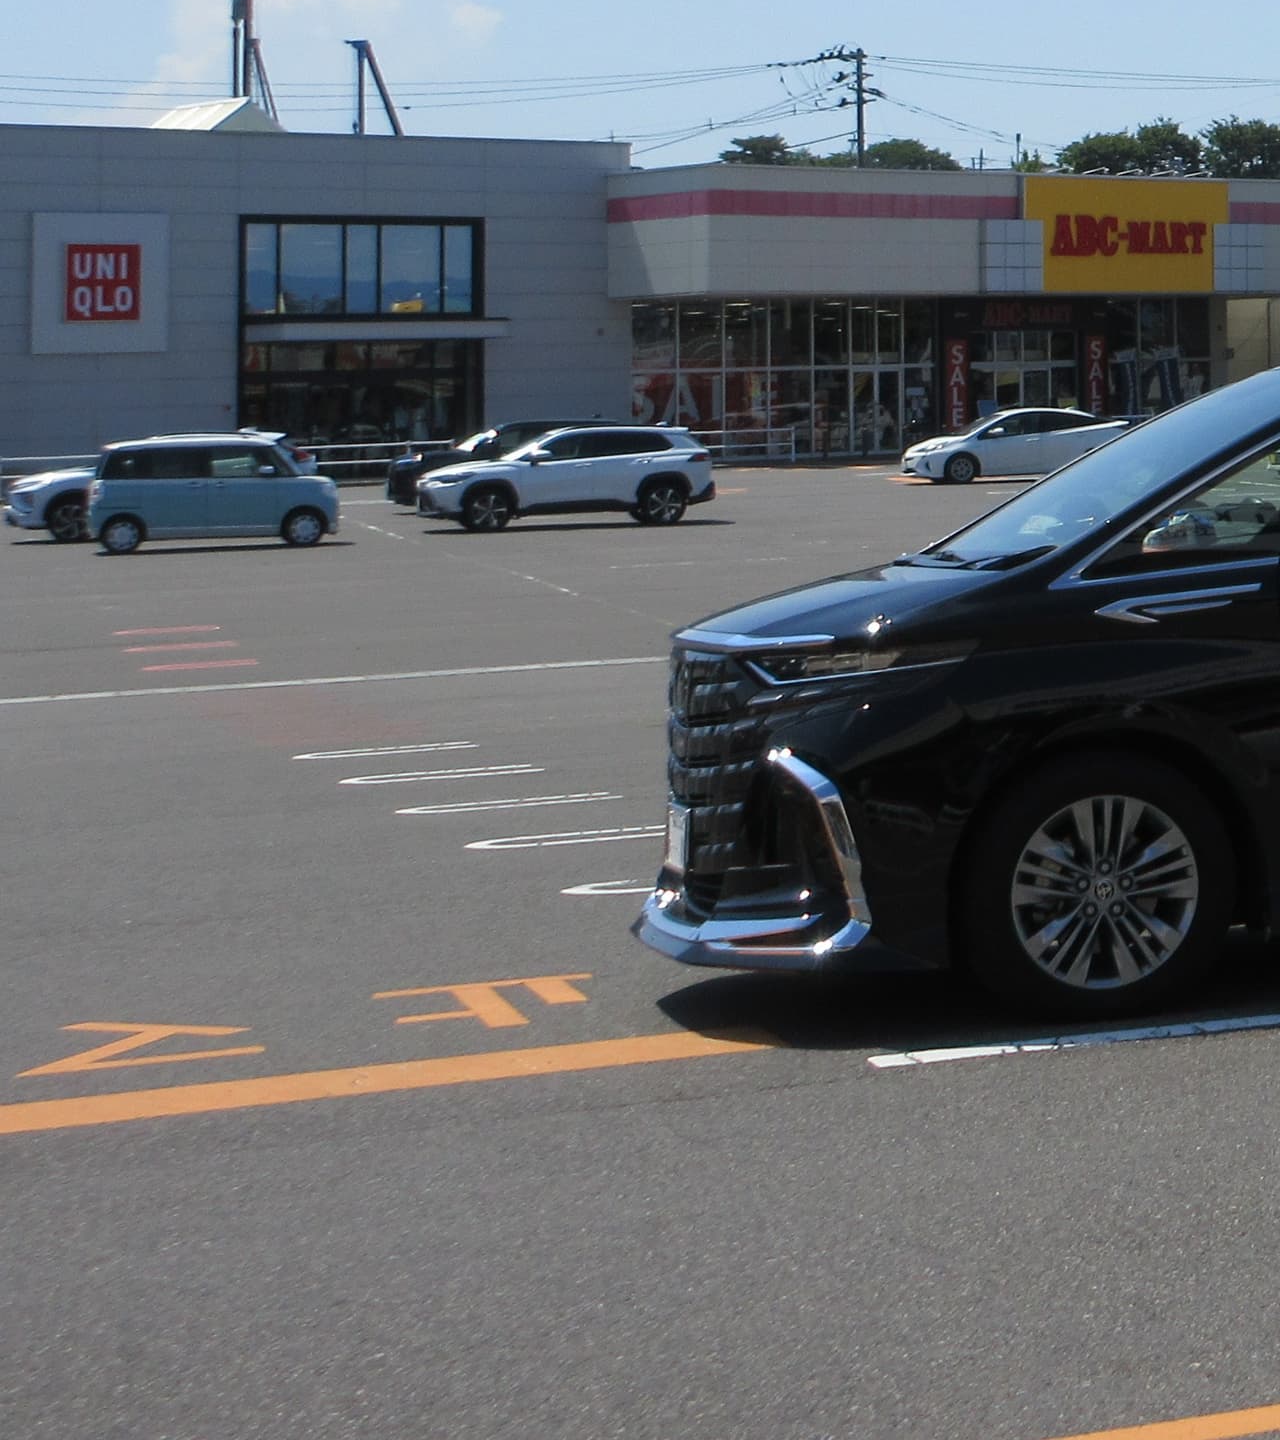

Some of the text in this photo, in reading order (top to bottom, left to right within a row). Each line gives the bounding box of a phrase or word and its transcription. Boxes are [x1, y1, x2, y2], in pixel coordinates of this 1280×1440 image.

[1050, 214, 1207, 257] ABC-MART
[72, 253, 129, 280] UNI
[73, 285, 134, 317] QLO
[950, 345, 966, 428] SALE
